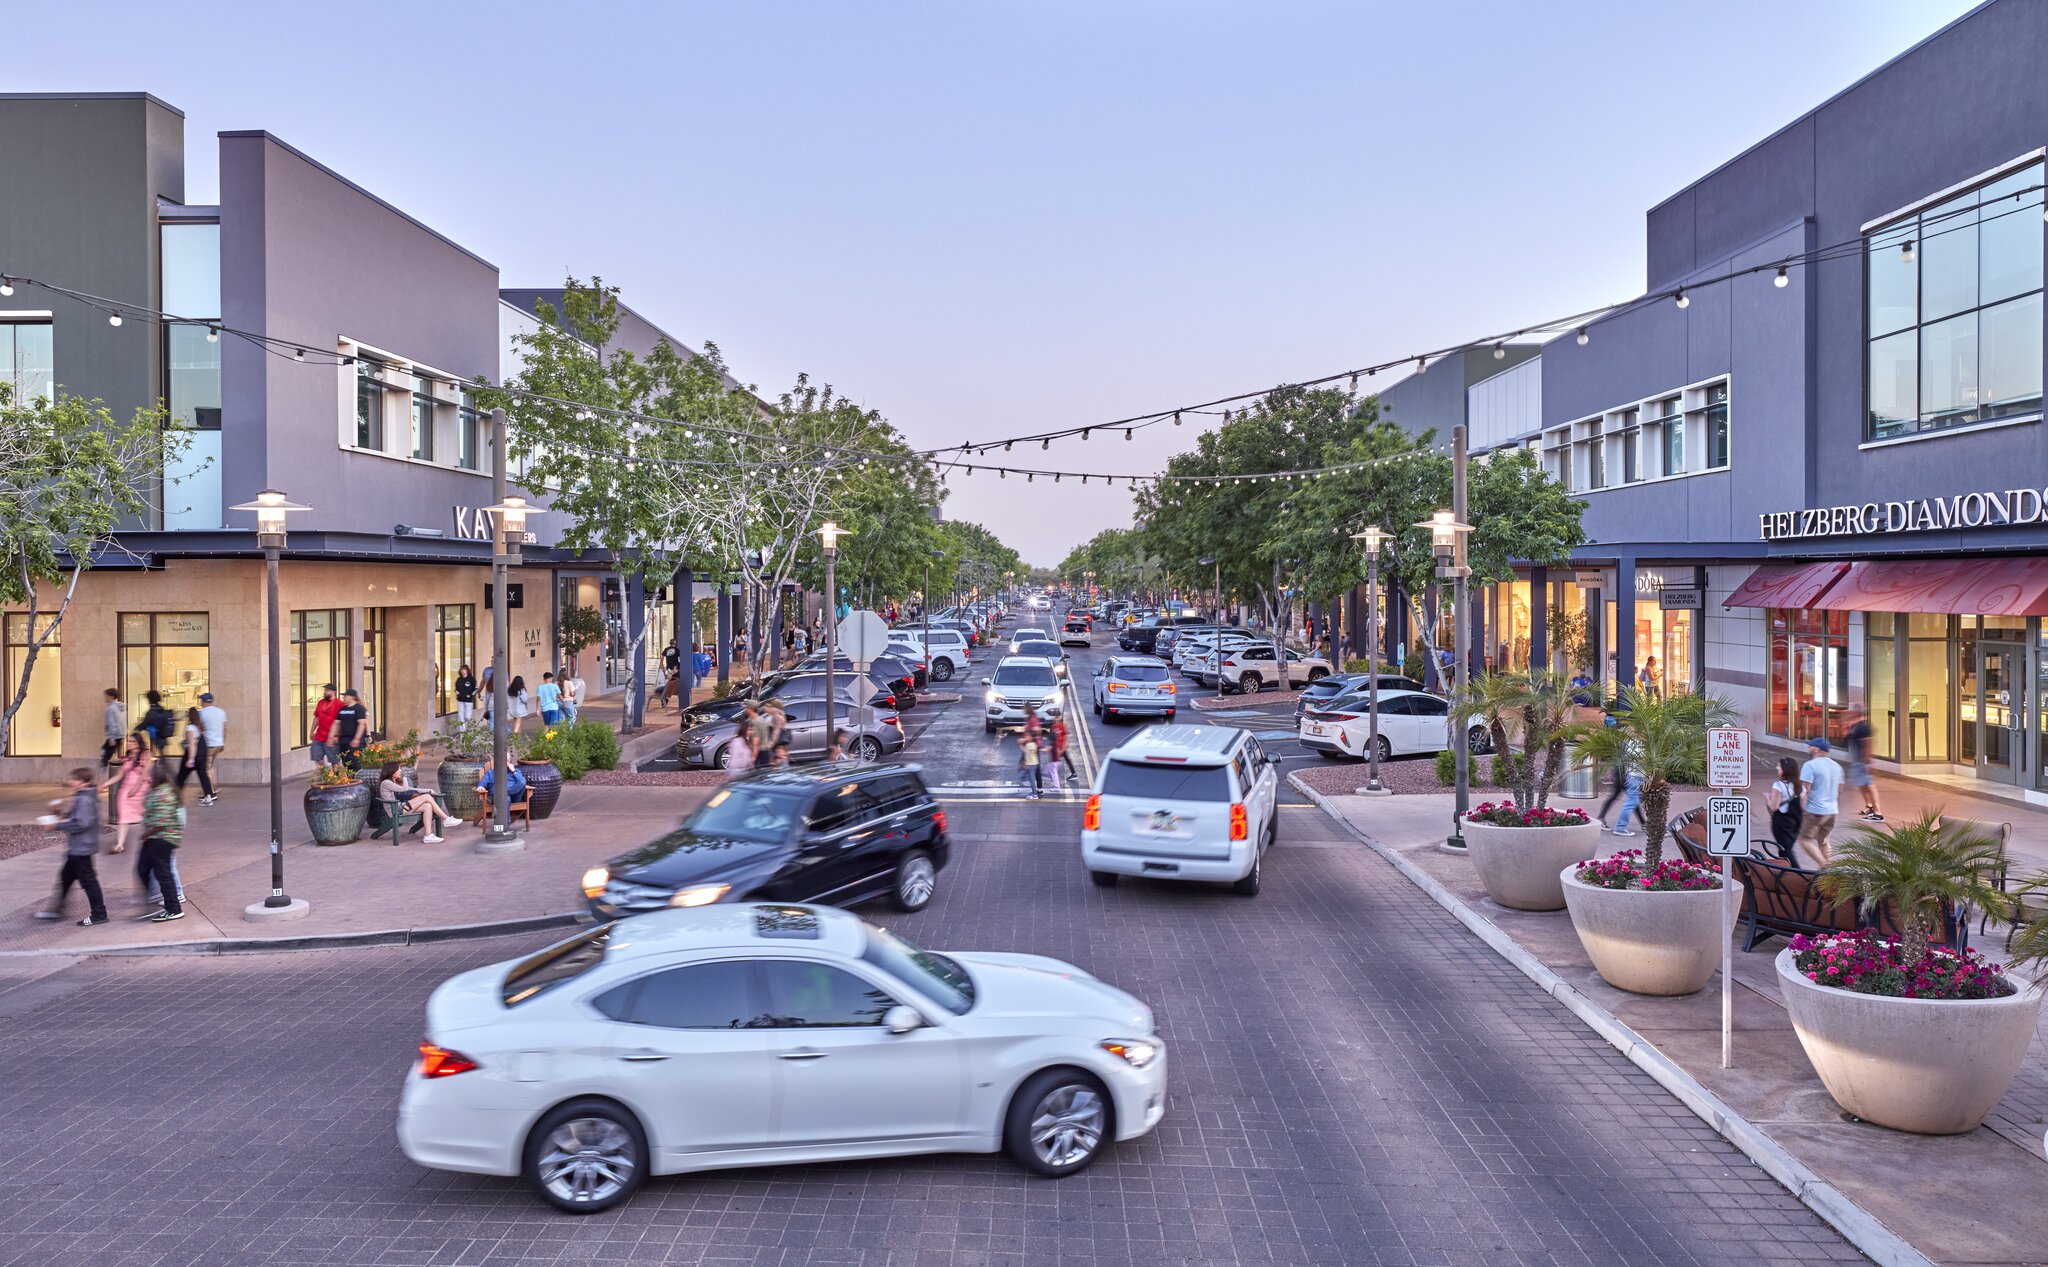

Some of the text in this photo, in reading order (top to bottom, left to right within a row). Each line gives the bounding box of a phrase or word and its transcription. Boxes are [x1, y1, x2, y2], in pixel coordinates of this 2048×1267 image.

[1759, 502, 1880, 540] HELZBERG
[525, 628, 541, 642] KAY
[1718, 732, 1739, 741] FIRE
[1716, 741, 1741, 749] LANE
[1713, 755, 1744, 763] PARKING
[1713, 801, 1745, 813] SPEED
[1714, 812, 1744, 825] LIMIT
[1722, 827, 1736, 850] 7
